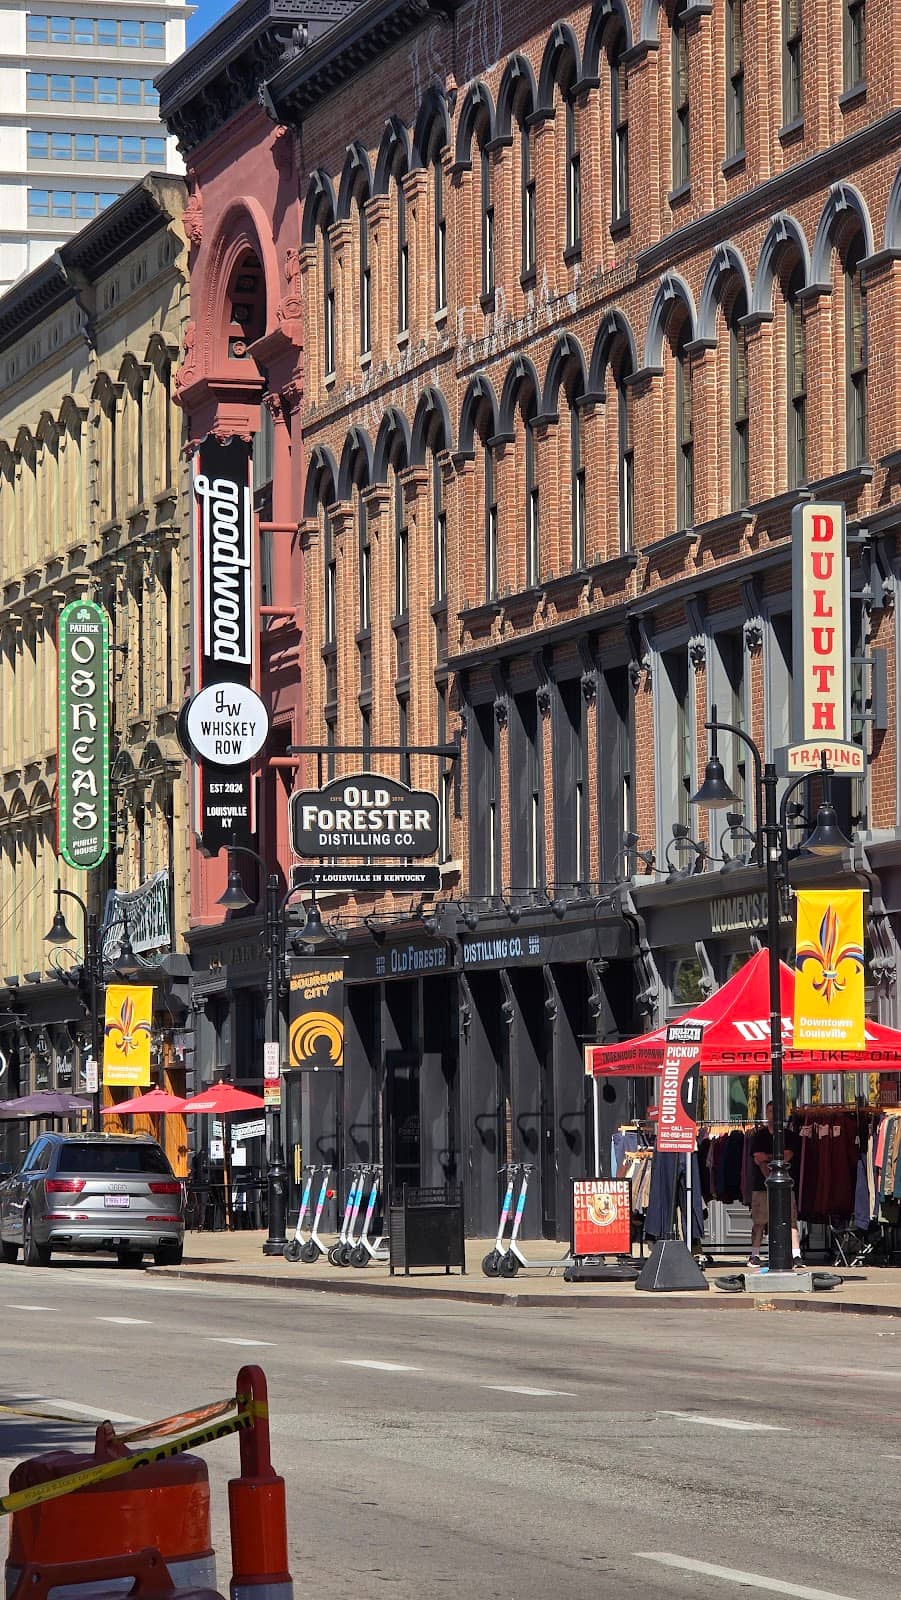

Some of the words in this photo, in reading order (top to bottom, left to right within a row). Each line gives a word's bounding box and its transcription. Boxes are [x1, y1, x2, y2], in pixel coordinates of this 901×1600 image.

[194, 474, 252, 664] goodwood
[69, 624, 99, 633] PATRICK
[811, 514, 835, 730] DULUTH
[201, 721, 256, 737] WHISKEY
[215, 740, 242, 755] ROW
[790, 748, 861, 766] TRADING
[209, 783, 224, 793] EST
[225, 783, 243, 793] 2024
[343, 786, 391, 809] OLD
[206, 806, 248, 817] LOUISVILLE
[302, 805, 432, 832] FORESTER
[221, 818, 233, 829] KY
[72, 837, 98, 849] PUBLIC
[319, 833, 391, 846] DISTILLING
[394, 833, 416, 846] CO.
[74, 845, 98, 857] HOUSE
[323, 874, 371, 882] LOUISVILLE
[373, 874, 382, 882] IN
[384, 874, 426, 882] KENTUCKY
[710, 893, 760, 933] WOMEN'S
[391, 948, 408, 973] OLD
[464, 939, 508, 963] DISTILLING
[509, 937, 523, 957] CO.
[290, 970, 344, 992] BOURBON
[304, 985, 329, 1000] CITY
[800, 1017, 853, 1027] Downtown
[800, 1029, 847, 1038] Louisville
[667, 1046, 699, 1058] PICKUP
[810, 1049, 850, 1062] LIKE
[661, 1059, 680, 1124] CURBSIDE
[687, 1076, 694, 1104] 1
[574, 1181, 629, 1195] CLEARANCE
